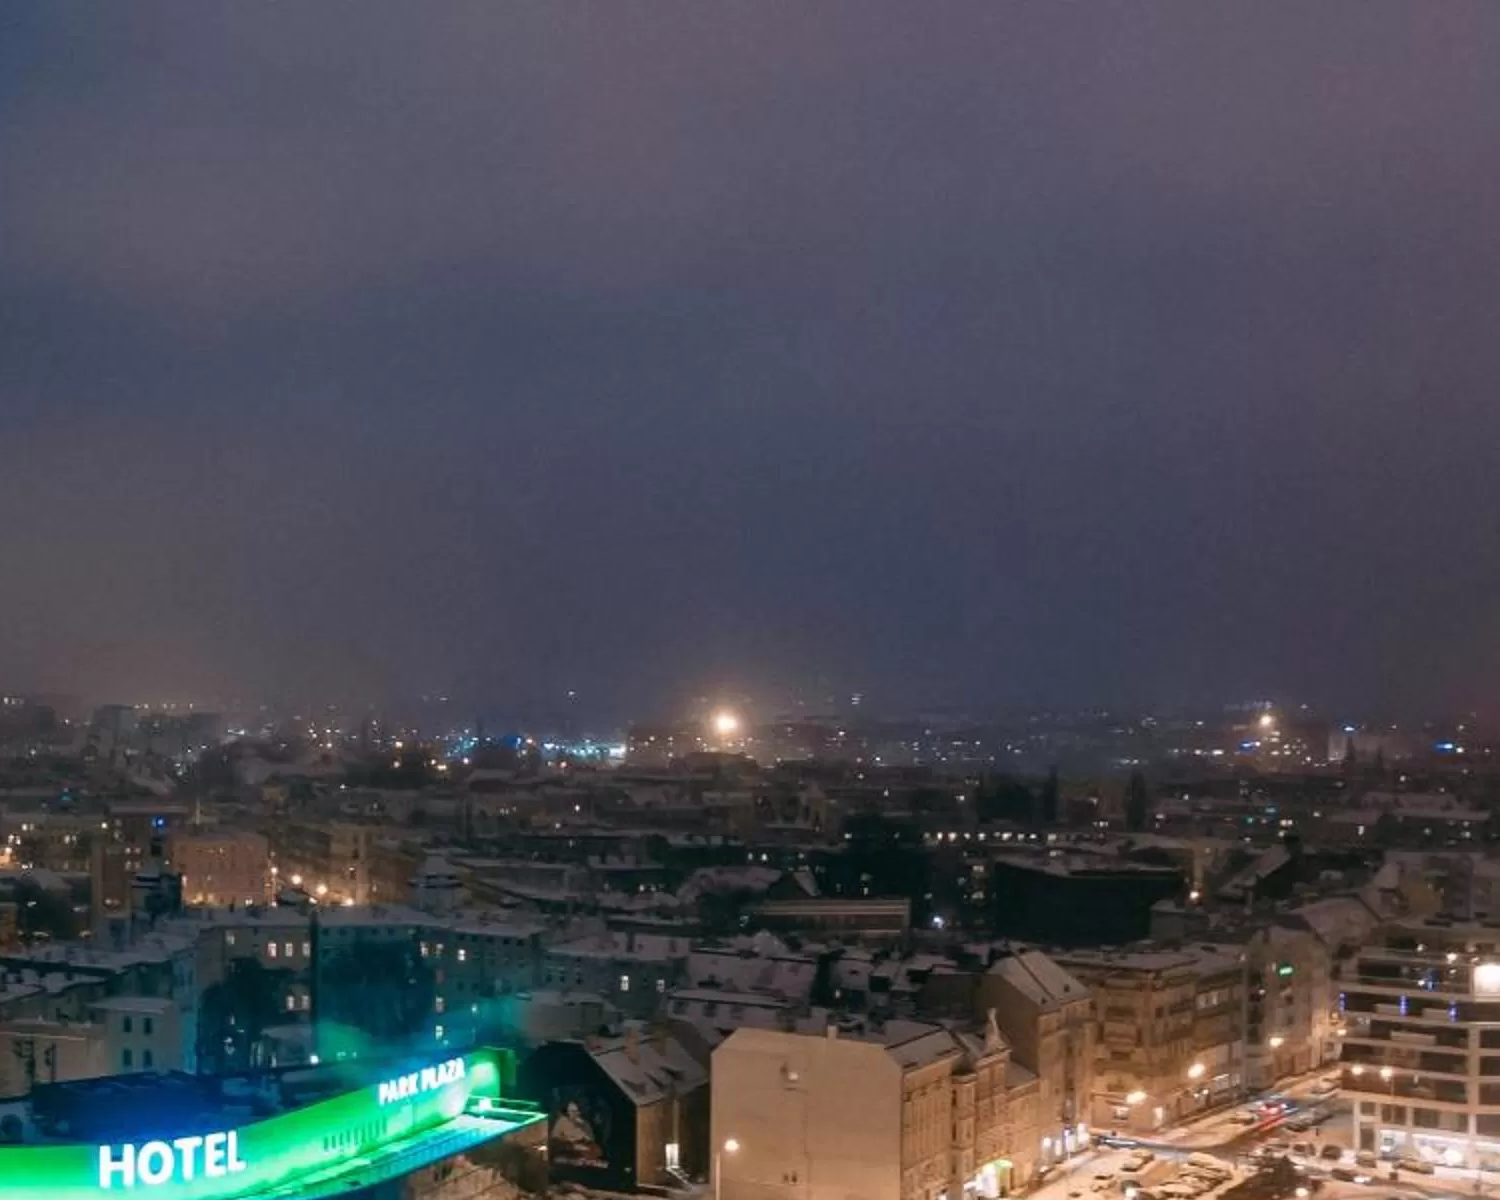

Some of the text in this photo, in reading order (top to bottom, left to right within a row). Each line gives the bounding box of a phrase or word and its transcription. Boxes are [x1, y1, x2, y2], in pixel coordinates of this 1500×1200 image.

[378, 1057, 465, 1106] PARK PLAZA
[99, 1129, 247, 1189] HOTEL
